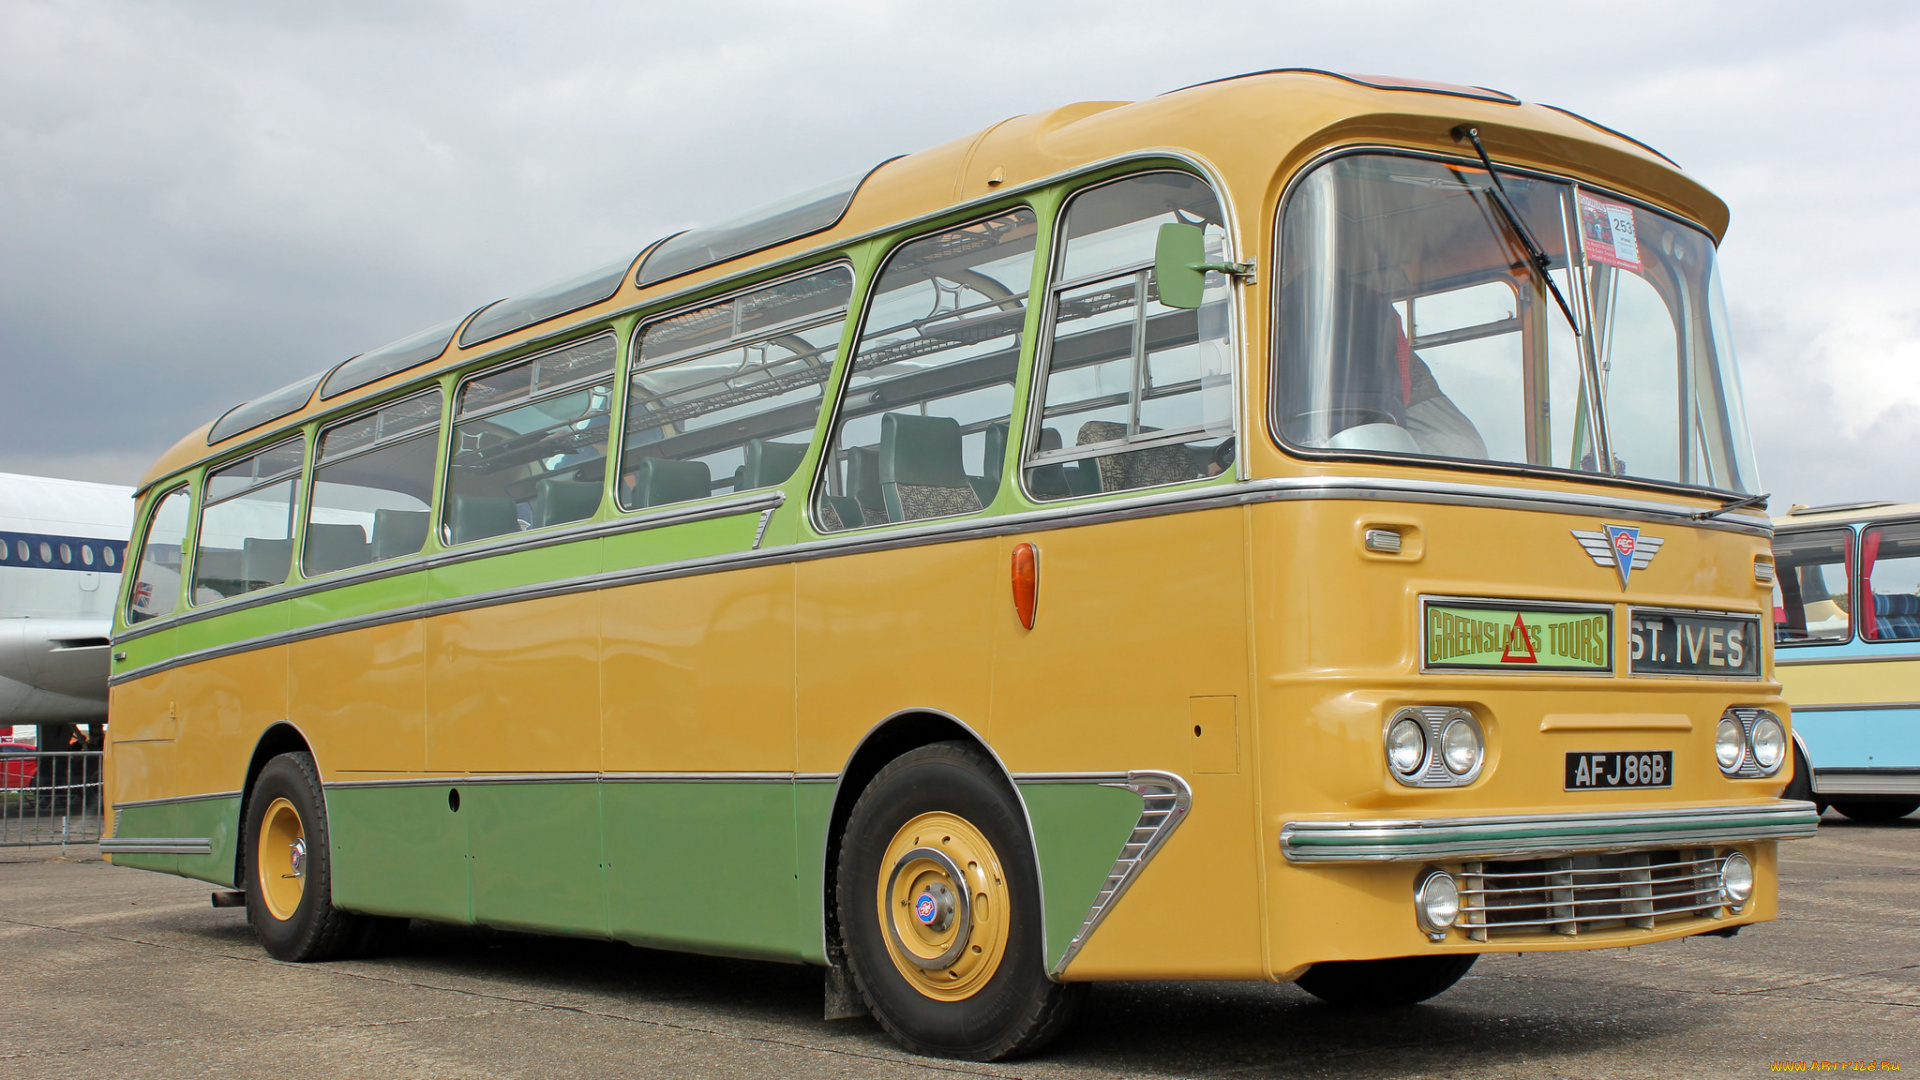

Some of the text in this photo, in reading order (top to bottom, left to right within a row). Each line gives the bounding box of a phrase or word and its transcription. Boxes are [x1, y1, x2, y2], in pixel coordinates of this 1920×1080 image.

[1613, 218, 1633, 235] 253
[1616, 538, 1633, 548] AEC
[1429, 608, 1604, 666] GREENSLADES TOURS
[1632, 620, 1744, 668] ST. IVES
